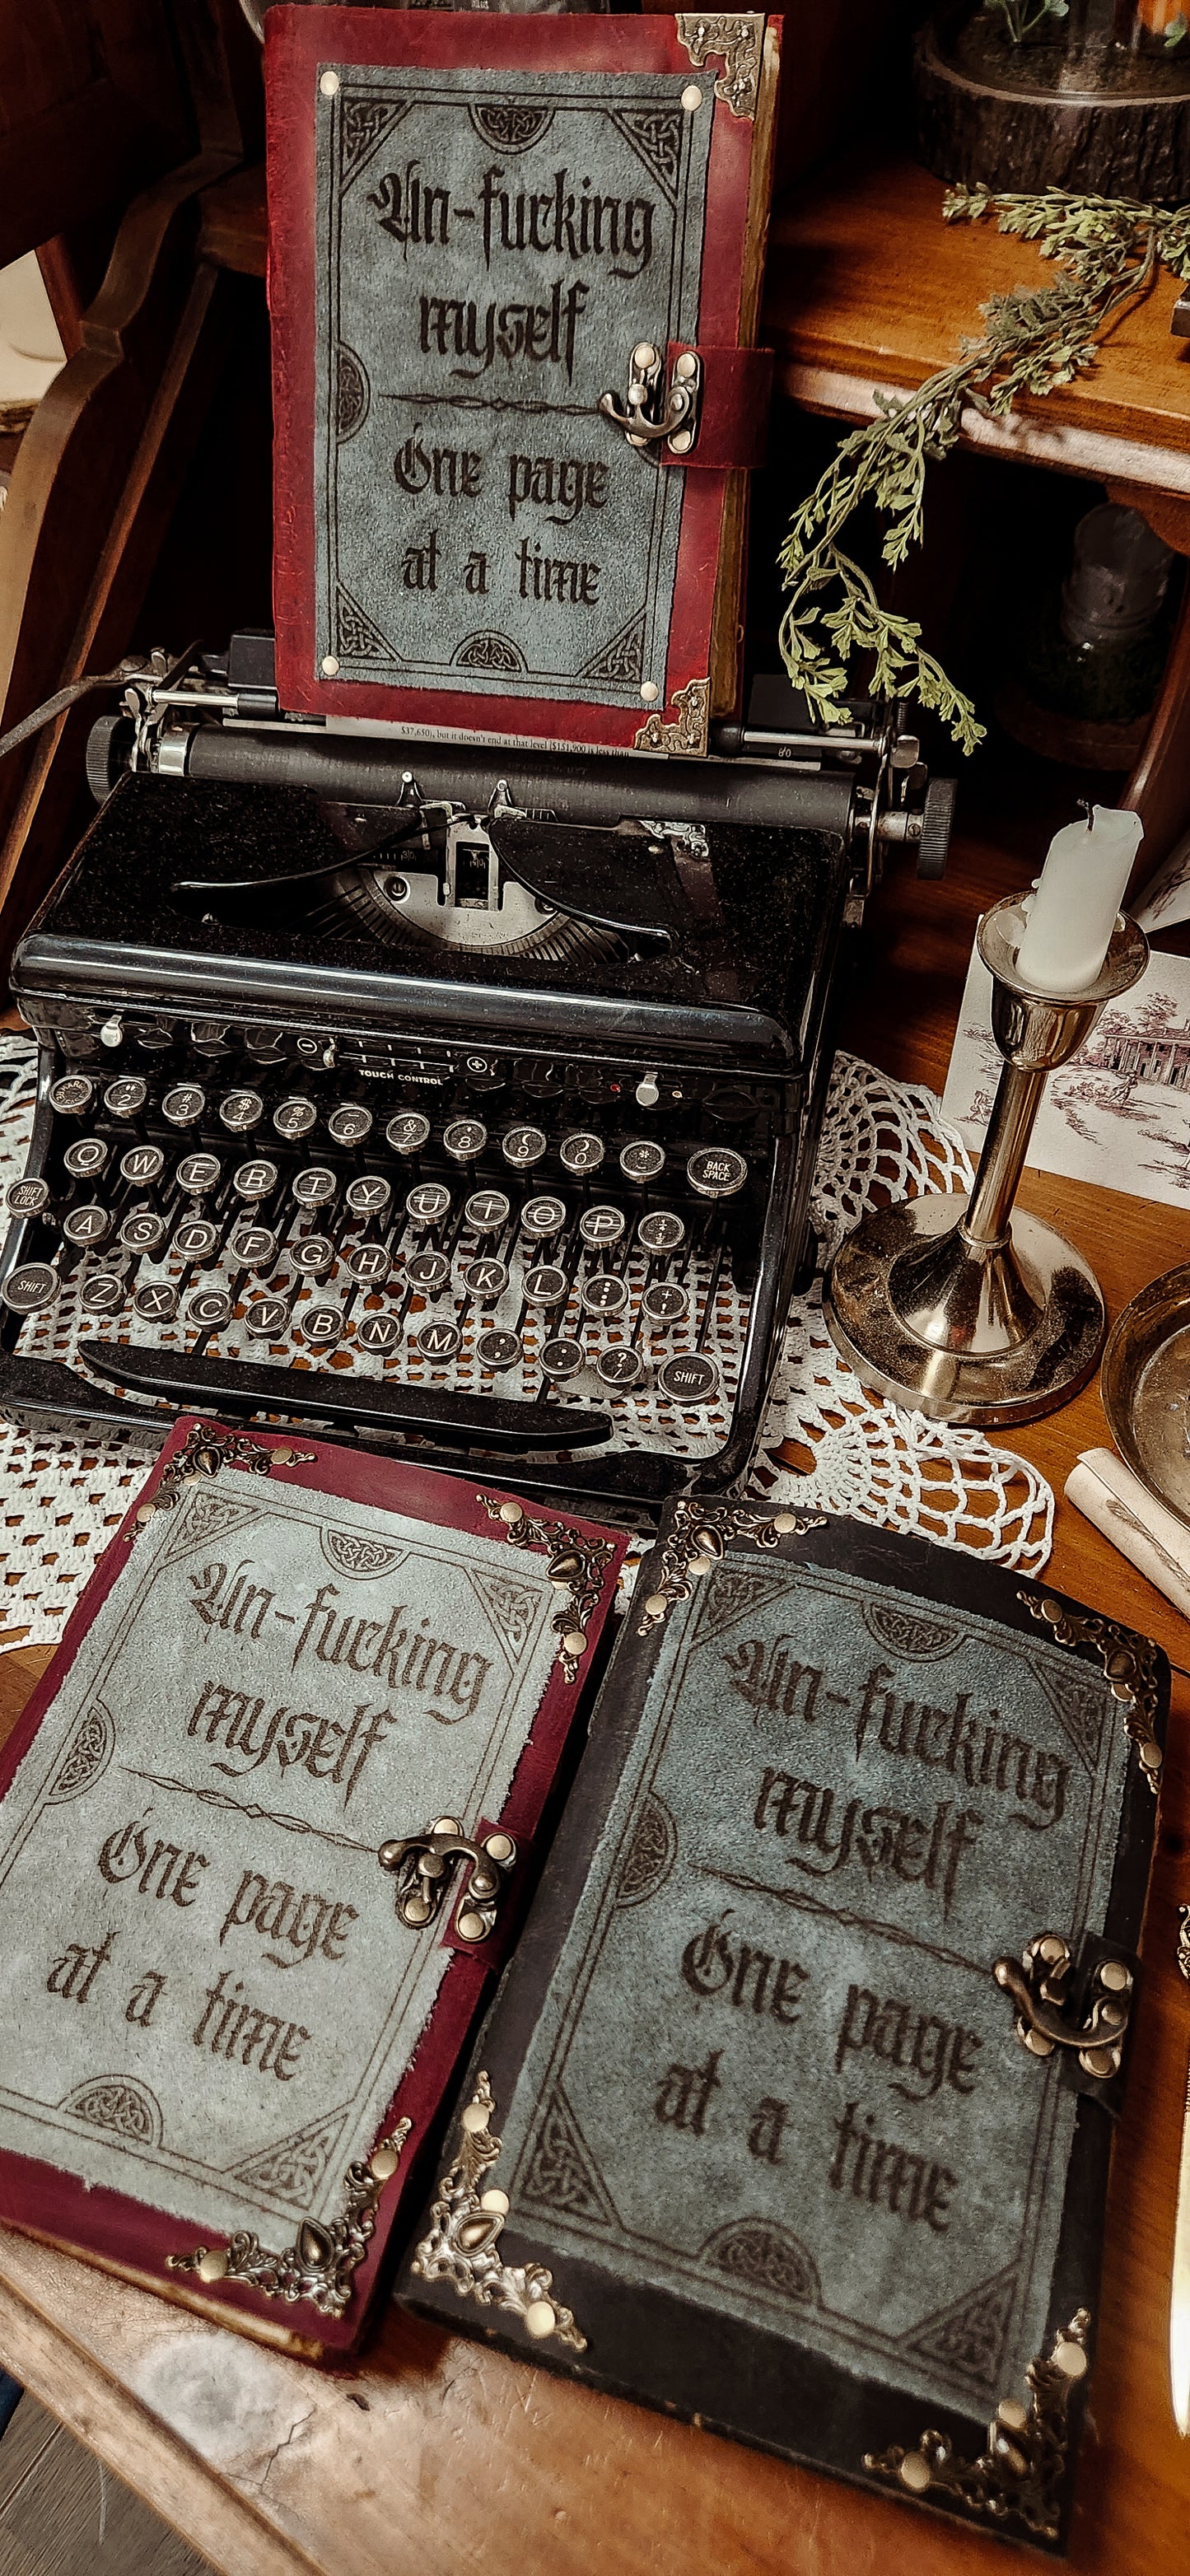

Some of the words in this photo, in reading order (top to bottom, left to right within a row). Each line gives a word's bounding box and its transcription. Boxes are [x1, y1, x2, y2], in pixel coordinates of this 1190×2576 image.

[367, 160, 656, 278] Un-fucking
[419, 278, 590, 386] myself
[394, 422, 483, 499] One
[508, 453, 609, 525] page
[401, 529, 441, 592] at
[463, 551, 491, 595] a
[515, 536, 601, 605] time
[401, 726, 436, 739] $37,650),
[436, 729, 449, 739] but
[459, 732, 485, 743] doesn't
[488, 736, 502, 744] end
[504, 738, 511, 746] at
[513, 735, 528, 748] that
[530, 740, 547, 749] level
[588, 745, 593, 754] is
[597, 745, 609, 755] less
[612, 748, 629, 757] than
[358, 1069, 394, 1080] TOUCH
[398, 1074, 443, 1085] CONTROL
[117, 1094, 132, 1106] 2
[239, 1098, 252, 1111] $
[175, 1104, 189, 1117] 3
[232, 1112, 245, 1121] 4
[287, 1117, 300, 1129] 5
[343, 1123, 356, 1136] 6
[403, 1119, 417, 1132] &
[403, 1132, 413, 1143] 7
[457, 1136, 471, 1149] 8
[77, 1146, 100, 1166] Q
[517, 1146, 530, 1157] 9
[133, 1154, 156, 1174] W
[189, 1162, 207, 1183] E
[706, 1160, 731, 1173] BACK
[308, 1175, 328, 1195] T
[702, 1169, 731, 1182] SPACE
[18, 1185, 43, 1195] SHIFT
[361, 1183, 381, 1205] Y
[14, 1195, 38, 1206] LOCK
[418, 1194, 441, 1214] U
[75, 1215, 92, 1234] A
[533, 1206, 556, 1225] O
[593, 1215, 614, 1235] P
[133, 1221, 153, 1241] S
[184, 1229, 208, 1248] D
[242, 1235, 264, 1255] F
[301, 1244, 324, 1264] G
[357, 1253, 380, 1273] H
[419, 1261, 437, 1281] J
[17, 1280, 48, 1294] SHIFT
[476, 1267, 497, 1288] K
[533, 1275, 552, 1295] L
[90, 1281, 115, 1303] Z
[143, 1289, 170, 1311] X
[199, 1299, 223, 1318] C
[260, 1306, 278, 1326] V
[312, 1313, 334, 1335] B
[368, 1322, 392, 1342] N
[427, 1329, 453, 1351] M
[673, 1370, 706, 1386] SHIFT
[188, 1559, 494, 1725] Un-fucking
[723, 1634, 1071, 1832] Un-fucking
[188, 1680, 397, 1813] myself
[754, 1766, 984, 1922] myself
[97, 1808, 211, 1907] One
[219, 1870, 360, 1969] page
[46, 1931, 121, 2004] at
[125, 1971, 168, 2028] a
[192, 1970, 312, 2082] time
[681, 1908, 811, 2025] One
[834, 1984, 984, 2103] page
[654, 2049, 726, 2137] at
[747, 2097, 792, 2166] a
[828, 2101, 959, 2233] time
